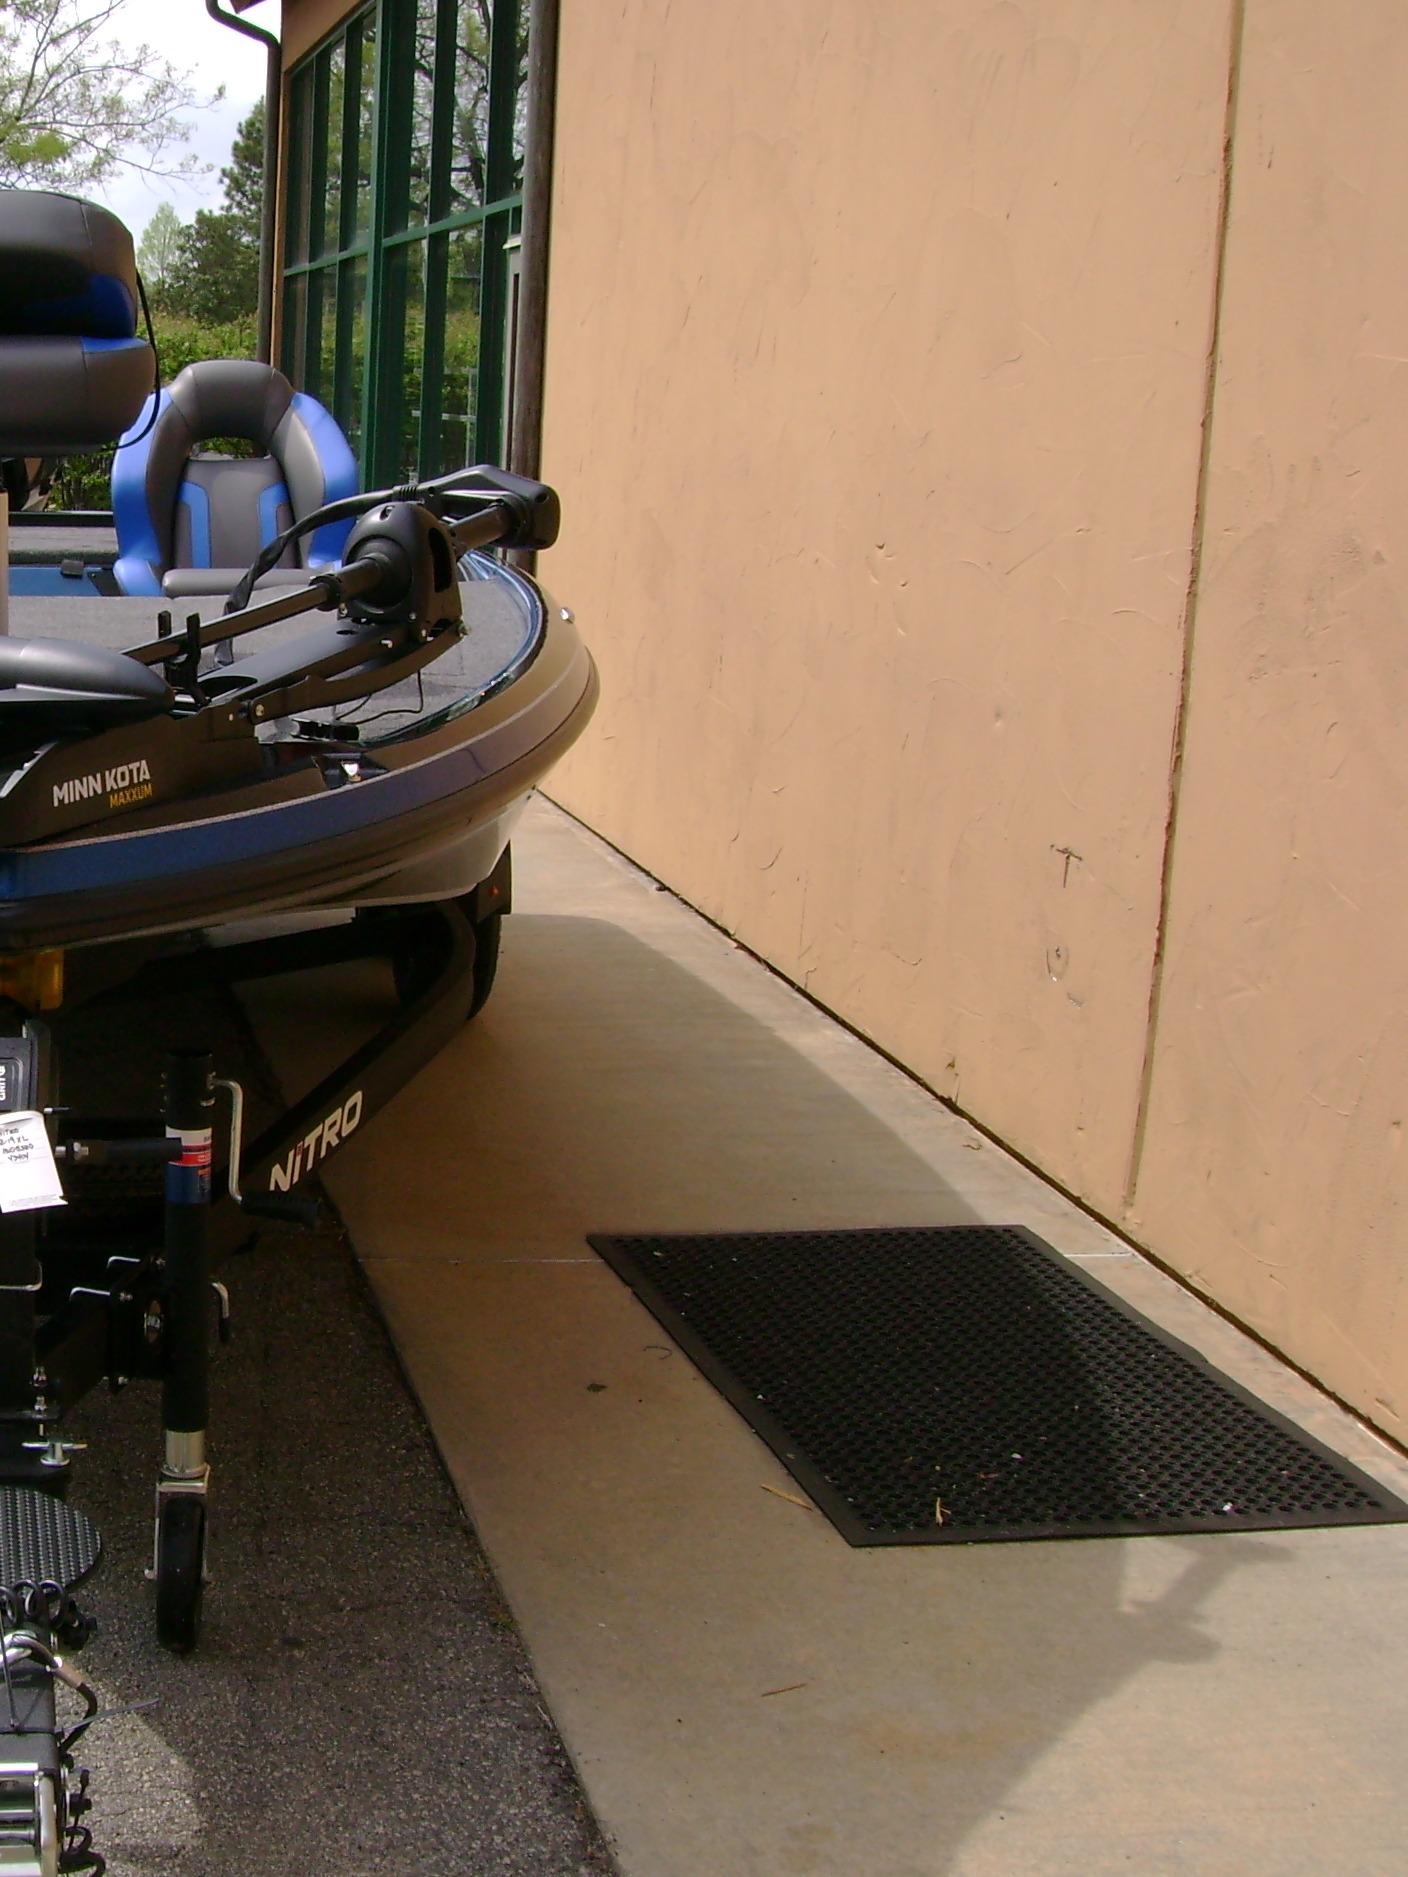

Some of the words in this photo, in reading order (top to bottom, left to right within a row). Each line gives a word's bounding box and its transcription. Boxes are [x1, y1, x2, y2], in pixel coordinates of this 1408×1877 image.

[52, 772, 103, 807] MINN
[105, 759, 151, 792] KOTA
[109, 783, 153, 808] MAXXUM
